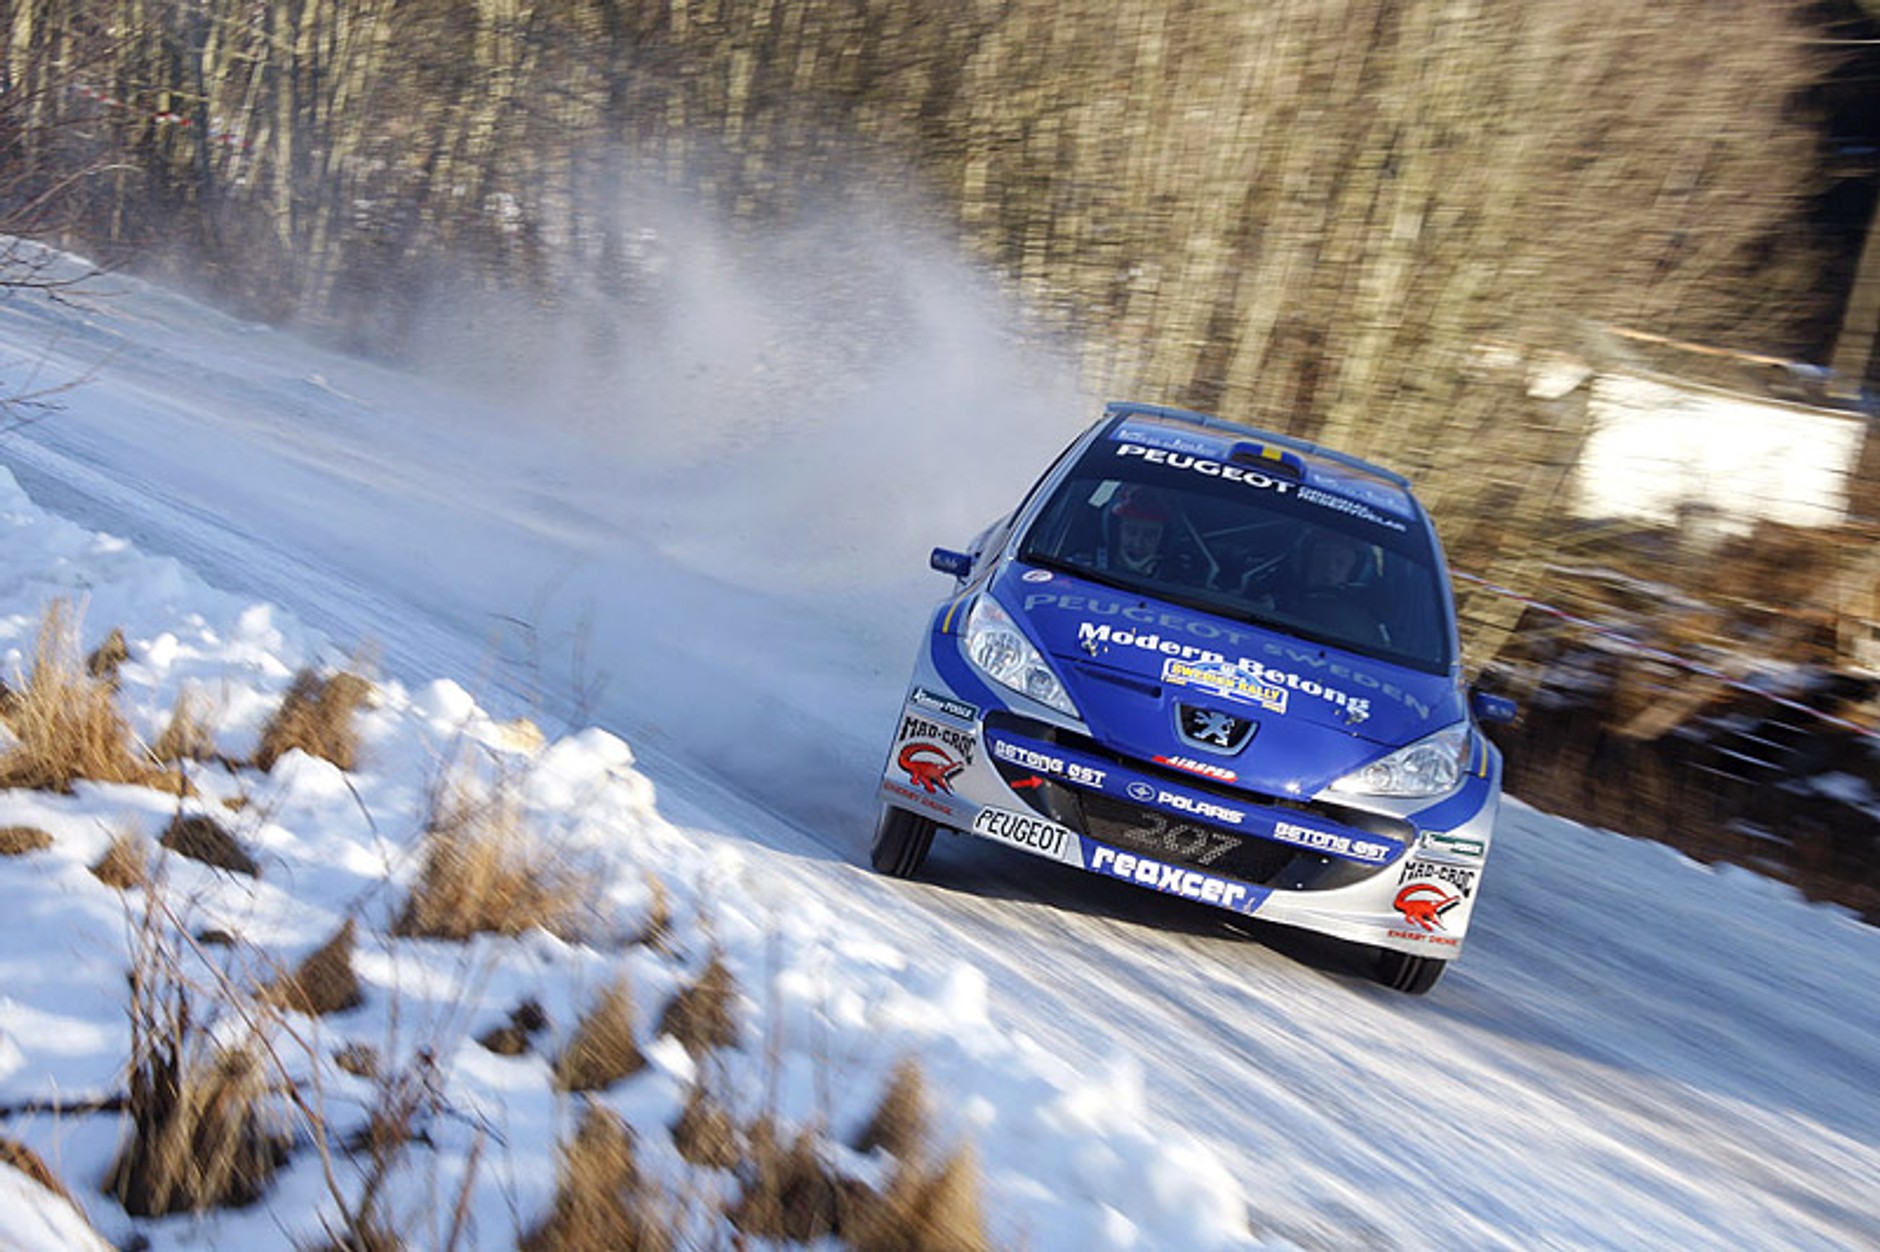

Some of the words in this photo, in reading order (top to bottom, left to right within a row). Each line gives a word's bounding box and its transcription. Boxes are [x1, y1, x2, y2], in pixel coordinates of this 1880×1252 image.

[1116, 443, 1297, 493] PEUGEOT
[1024, 595, 1250, 645] PEUGEOT
[1263, 643, 1430, 720] SWEDEN
[1078, 622, 1224, 664] Modern
[1238, 657, 1370, 720] Betong
[1238, 682, 1280, 701] RALLY
[974, 810, 1069, 854] PEUGEOT
[1158, 791, 1247, 824] POLARIS
[1124, 812, 1243, 866] 207
[1091, 845, 1247, 906] reaxcer
